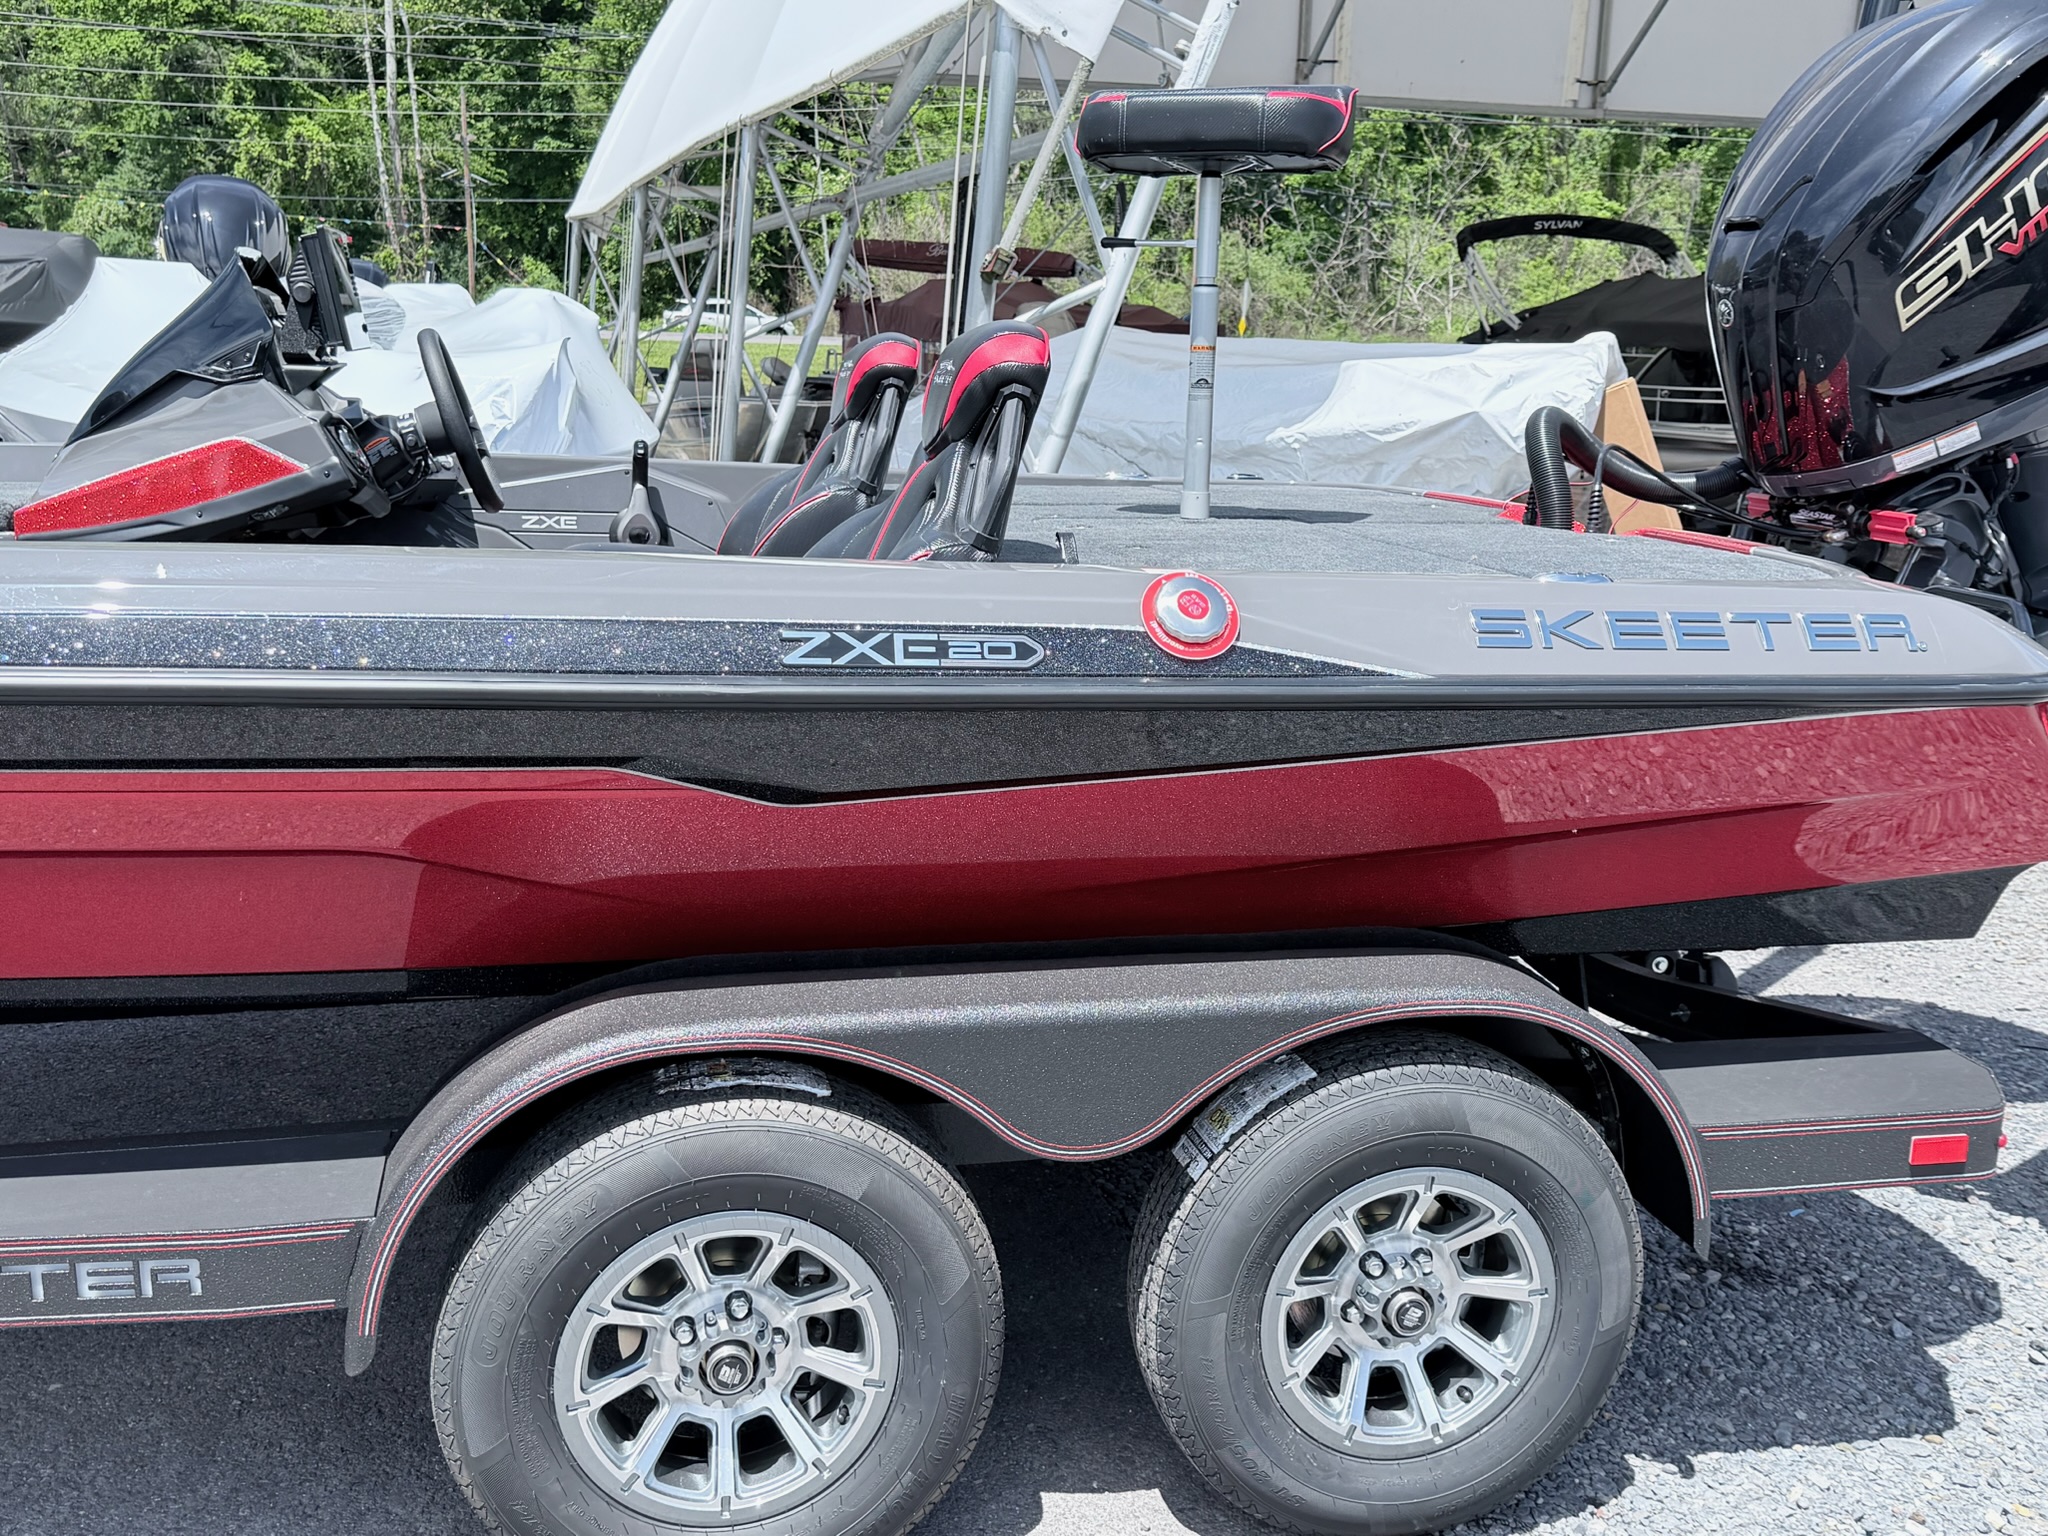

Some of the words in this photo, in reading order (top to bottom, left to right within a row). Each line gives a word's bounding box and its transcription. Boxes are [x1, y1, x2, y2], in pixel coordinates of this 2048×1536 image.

[1533, 220, 1584, 230] SYLVAN
[521, 515, 578, 529] ZXE
[1798, 508, 1836, 520] SEASTAR
[781, 630, 940, 667] ZXE
[947, 641, 1017, 660] 20
[1469, 608, 1919, 652] SKEETER
[1248, 1110, 1395, 1222] JOURNEY
[0, 1258, 203, 1303] TER
[480, 1190, 598, 1361] JOURNEY
